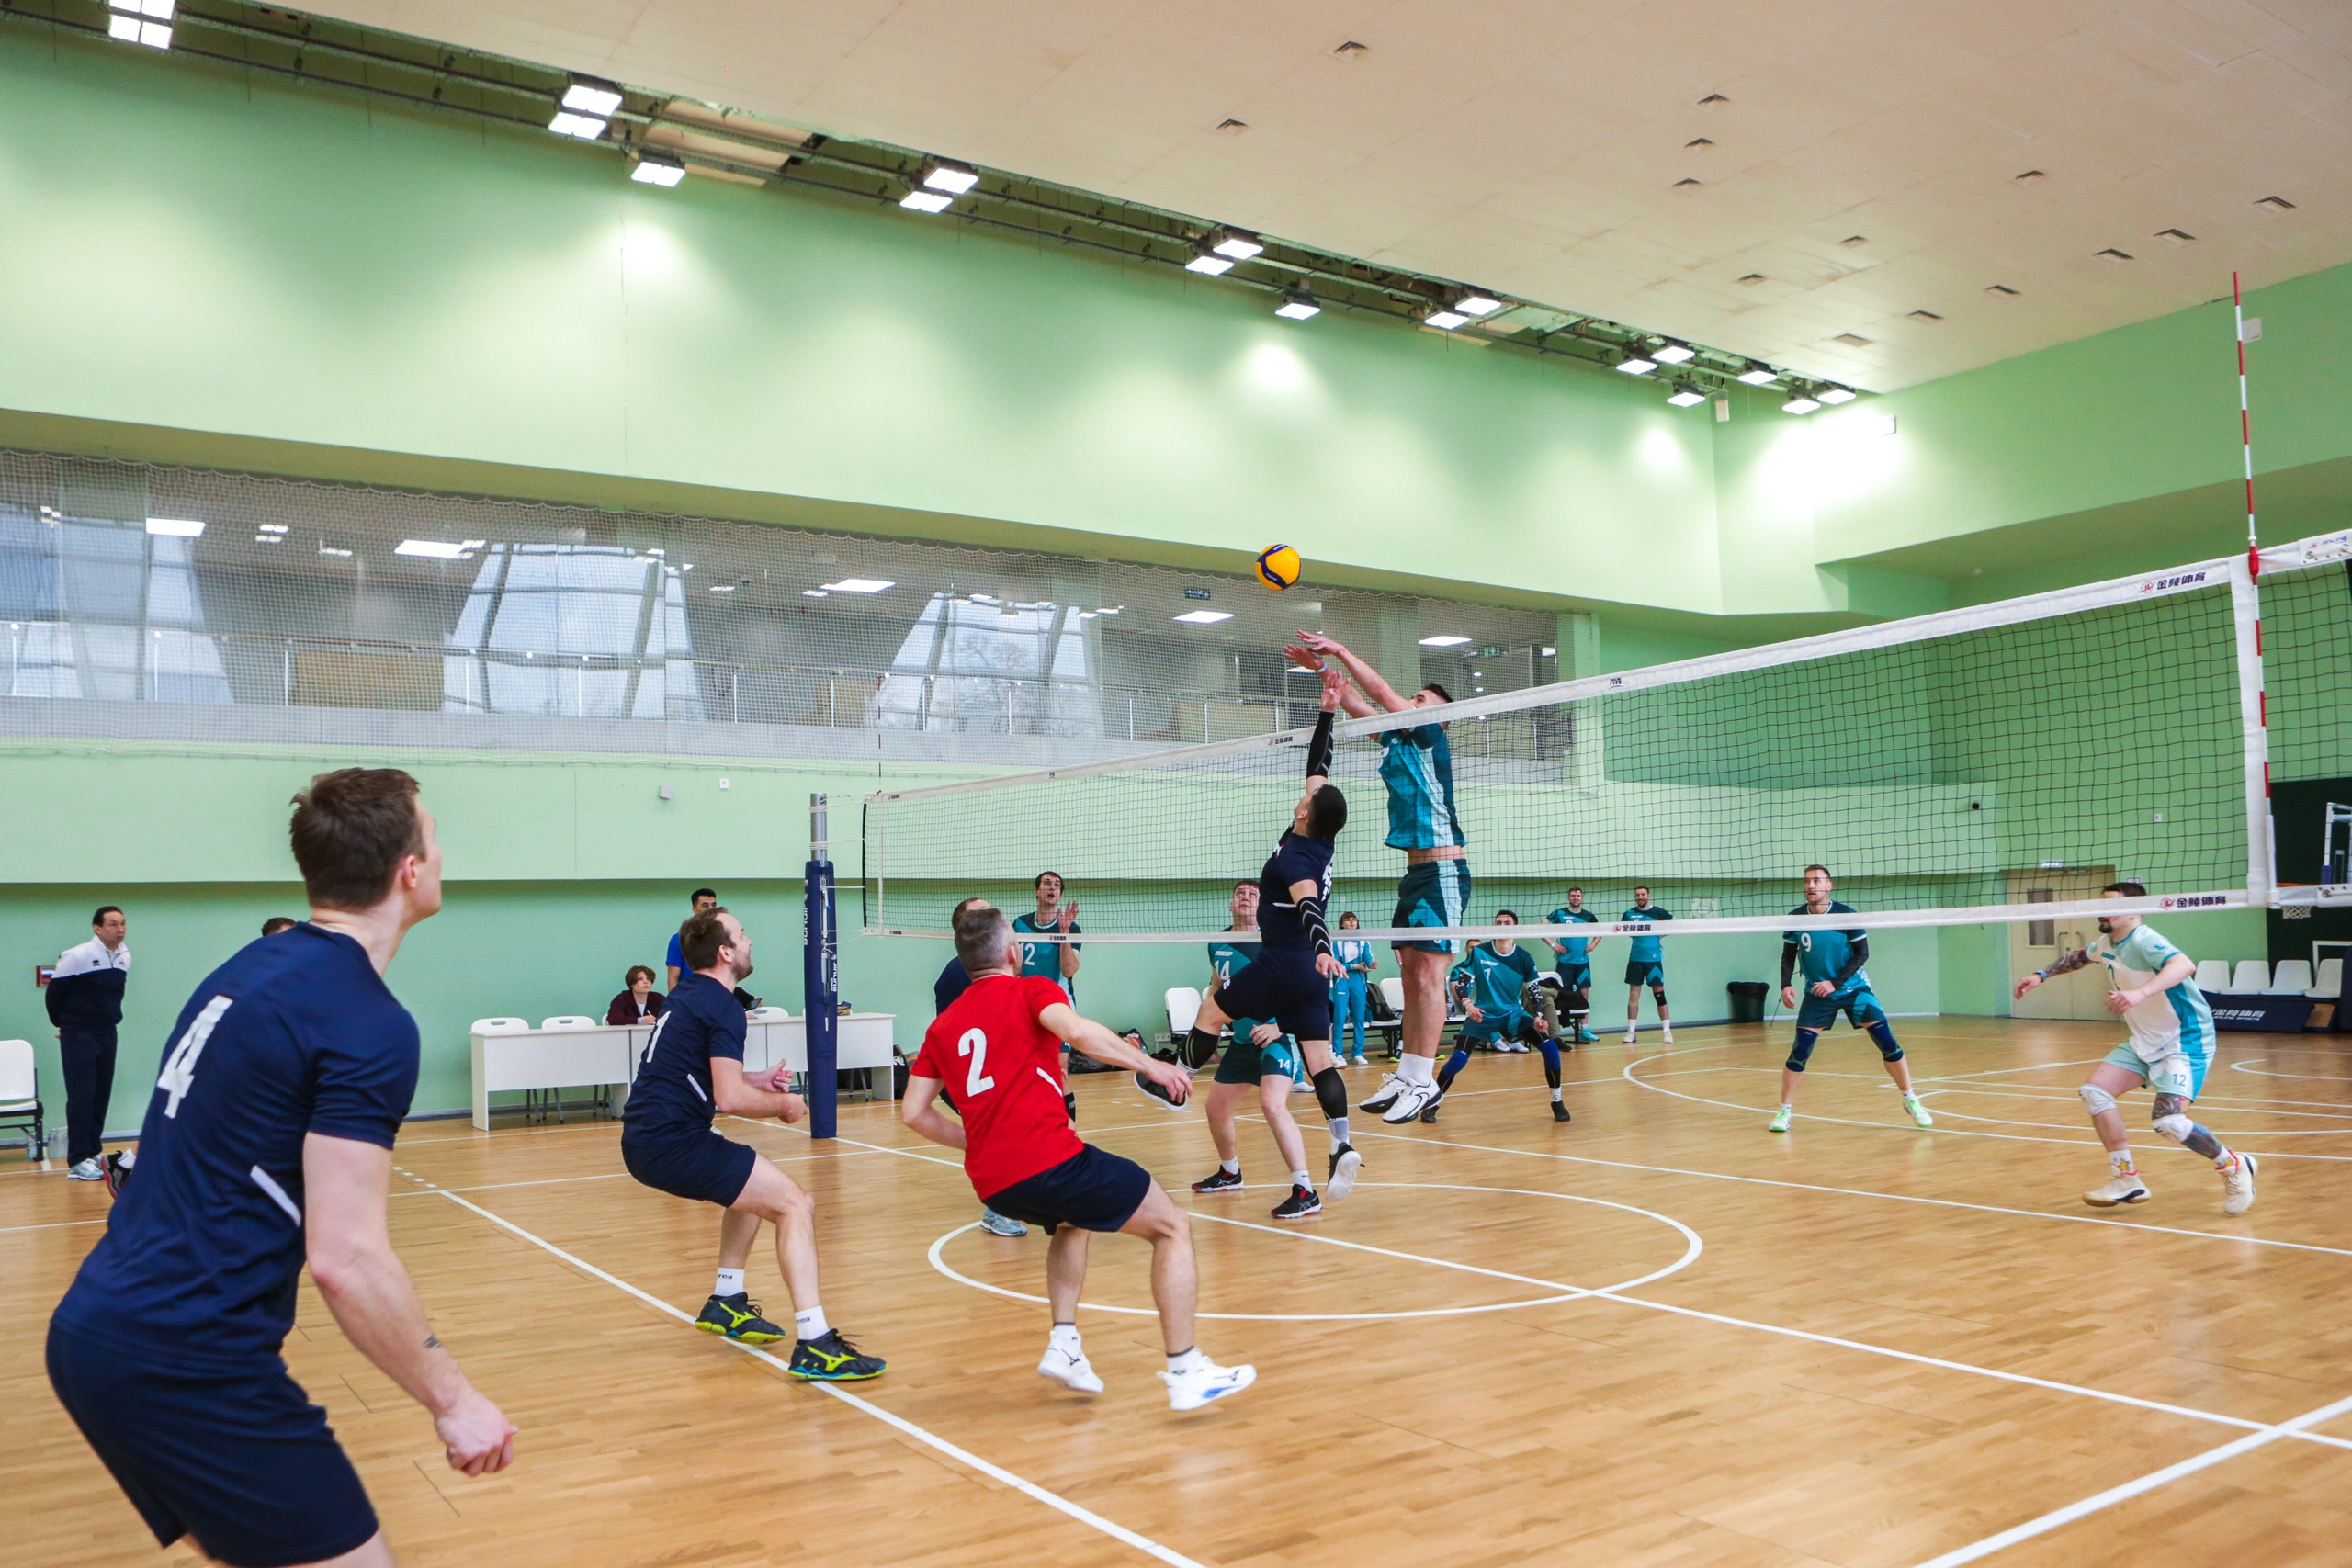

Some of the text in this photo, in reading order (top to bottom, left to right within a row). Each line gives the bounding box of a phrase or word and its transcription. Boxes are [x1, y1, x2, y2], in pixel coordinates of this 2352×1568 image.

[2156, 571, 2207, 590] 金陵体育
[2177, 895, 2227, 908] 金陵体育
[1801, 932, 1812, 953] 9
[1214, 960, 1231, 980] 14
[156, 994, 233, 1119] 4
[957, 1027, 995, 1098] 2
[1278, 1058, 1291, 1070] 14
[2172, 1073, 2187, 1087] 12
